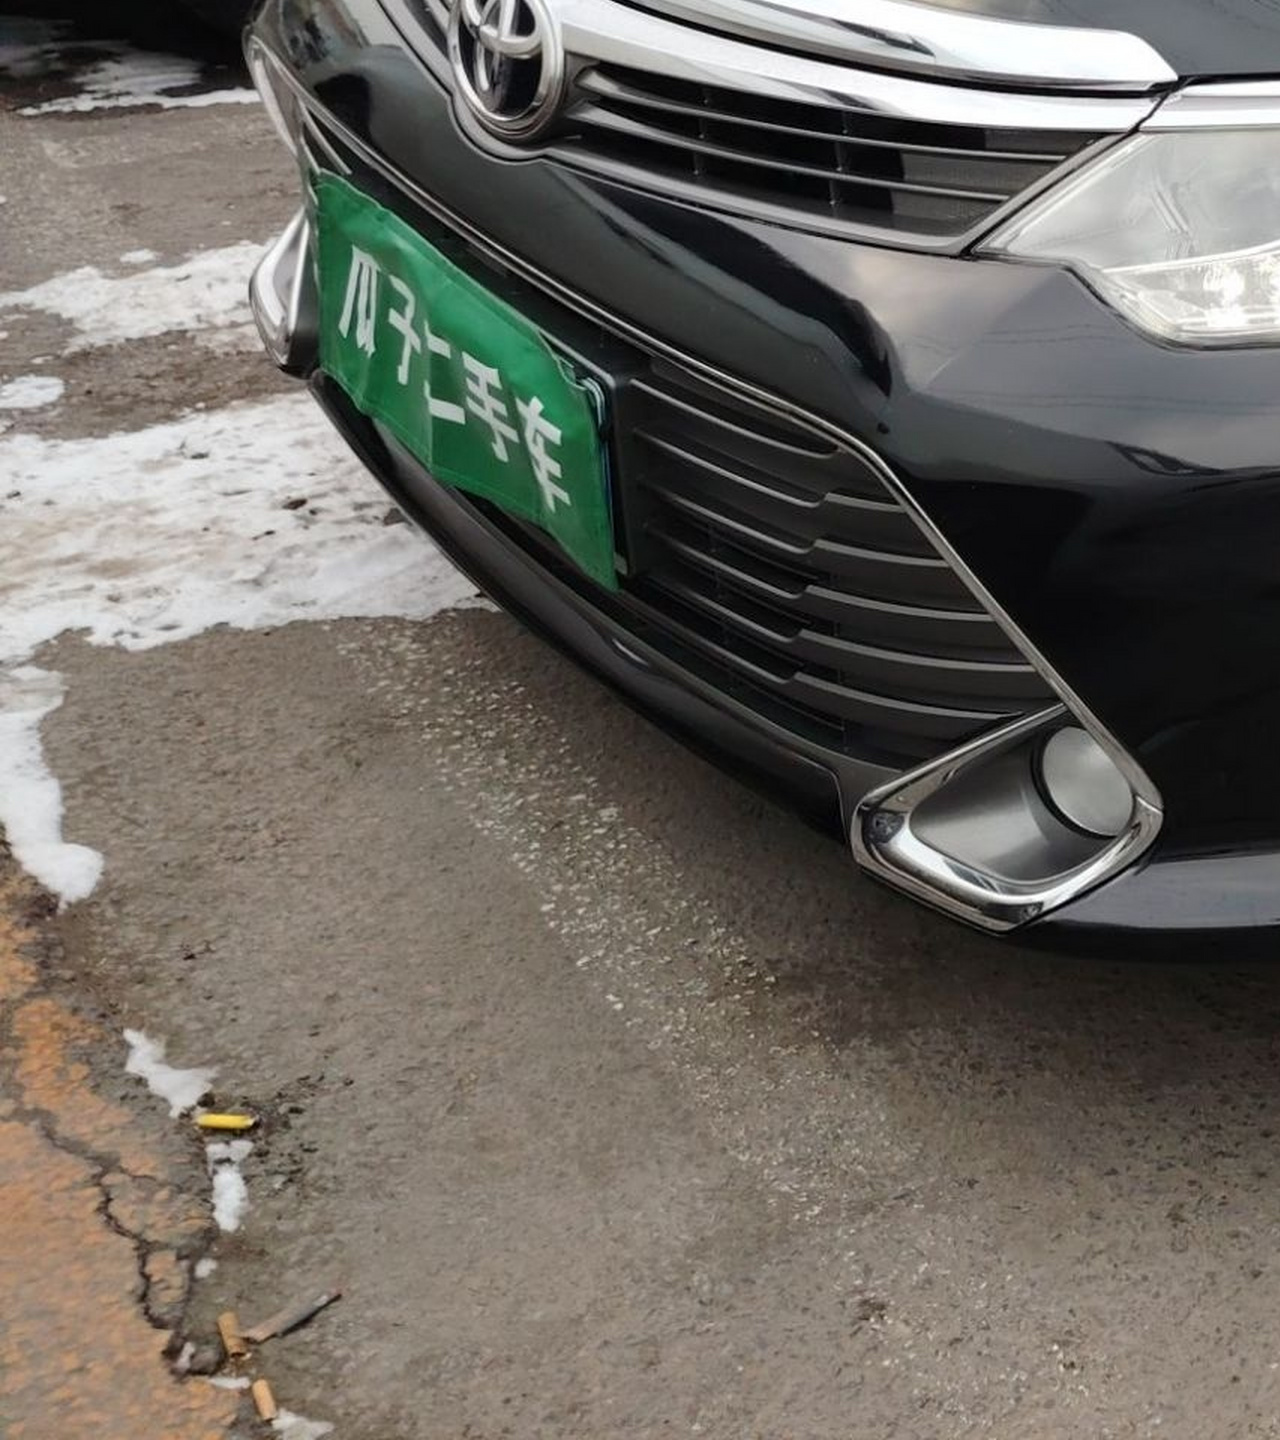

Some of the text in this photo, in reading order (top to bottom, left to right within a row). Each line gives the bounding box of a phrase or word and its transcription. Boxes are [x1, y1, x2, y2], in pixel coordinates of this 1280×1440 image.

[338, 244, 572, 513] 瓜子二手车
